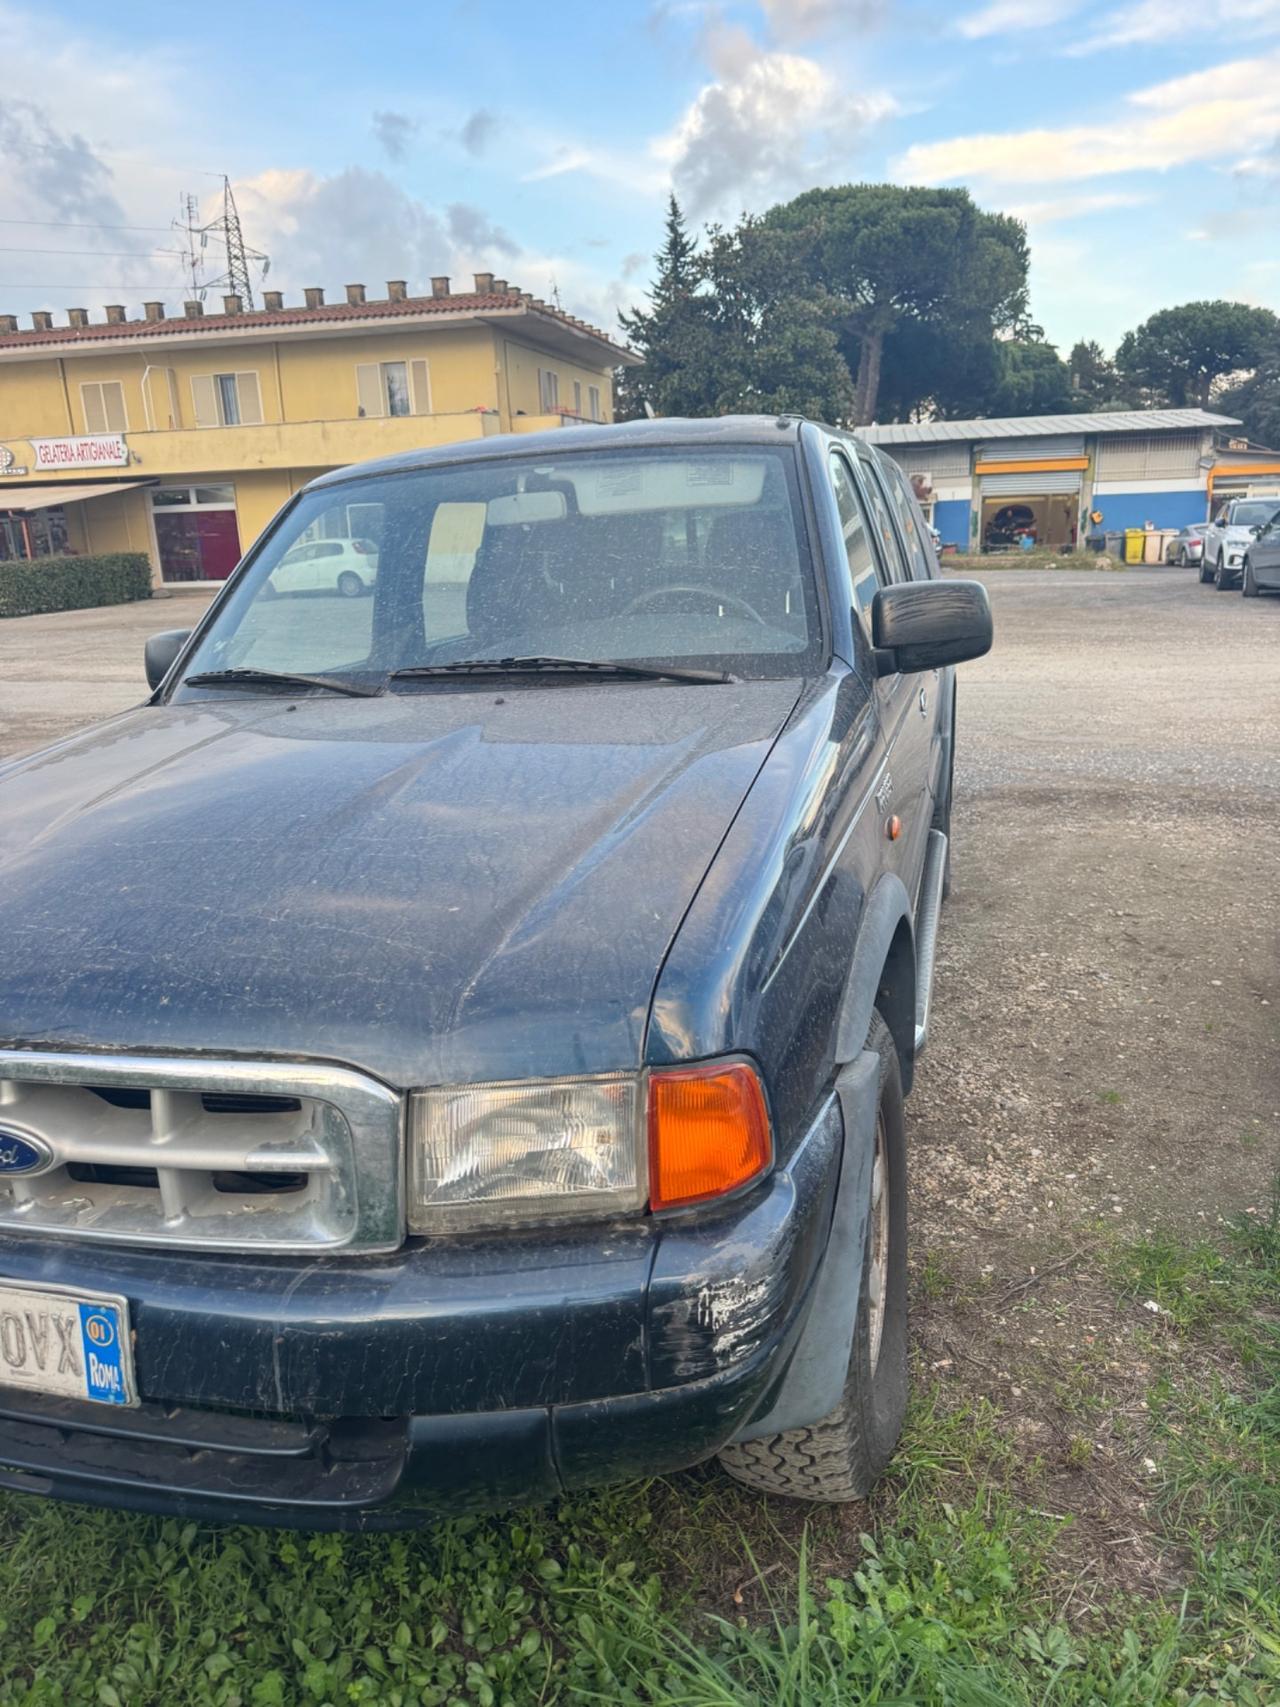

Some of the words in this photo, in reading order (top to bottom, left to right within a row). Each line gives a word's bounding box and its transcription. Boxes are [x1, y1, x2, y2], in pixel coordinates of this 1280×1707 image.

[39, 444, 75, 463] GELATERIA
[77, 441, 122, 461] ARTIGIANALE
[89, 1352, 121, 1392] ROMA
